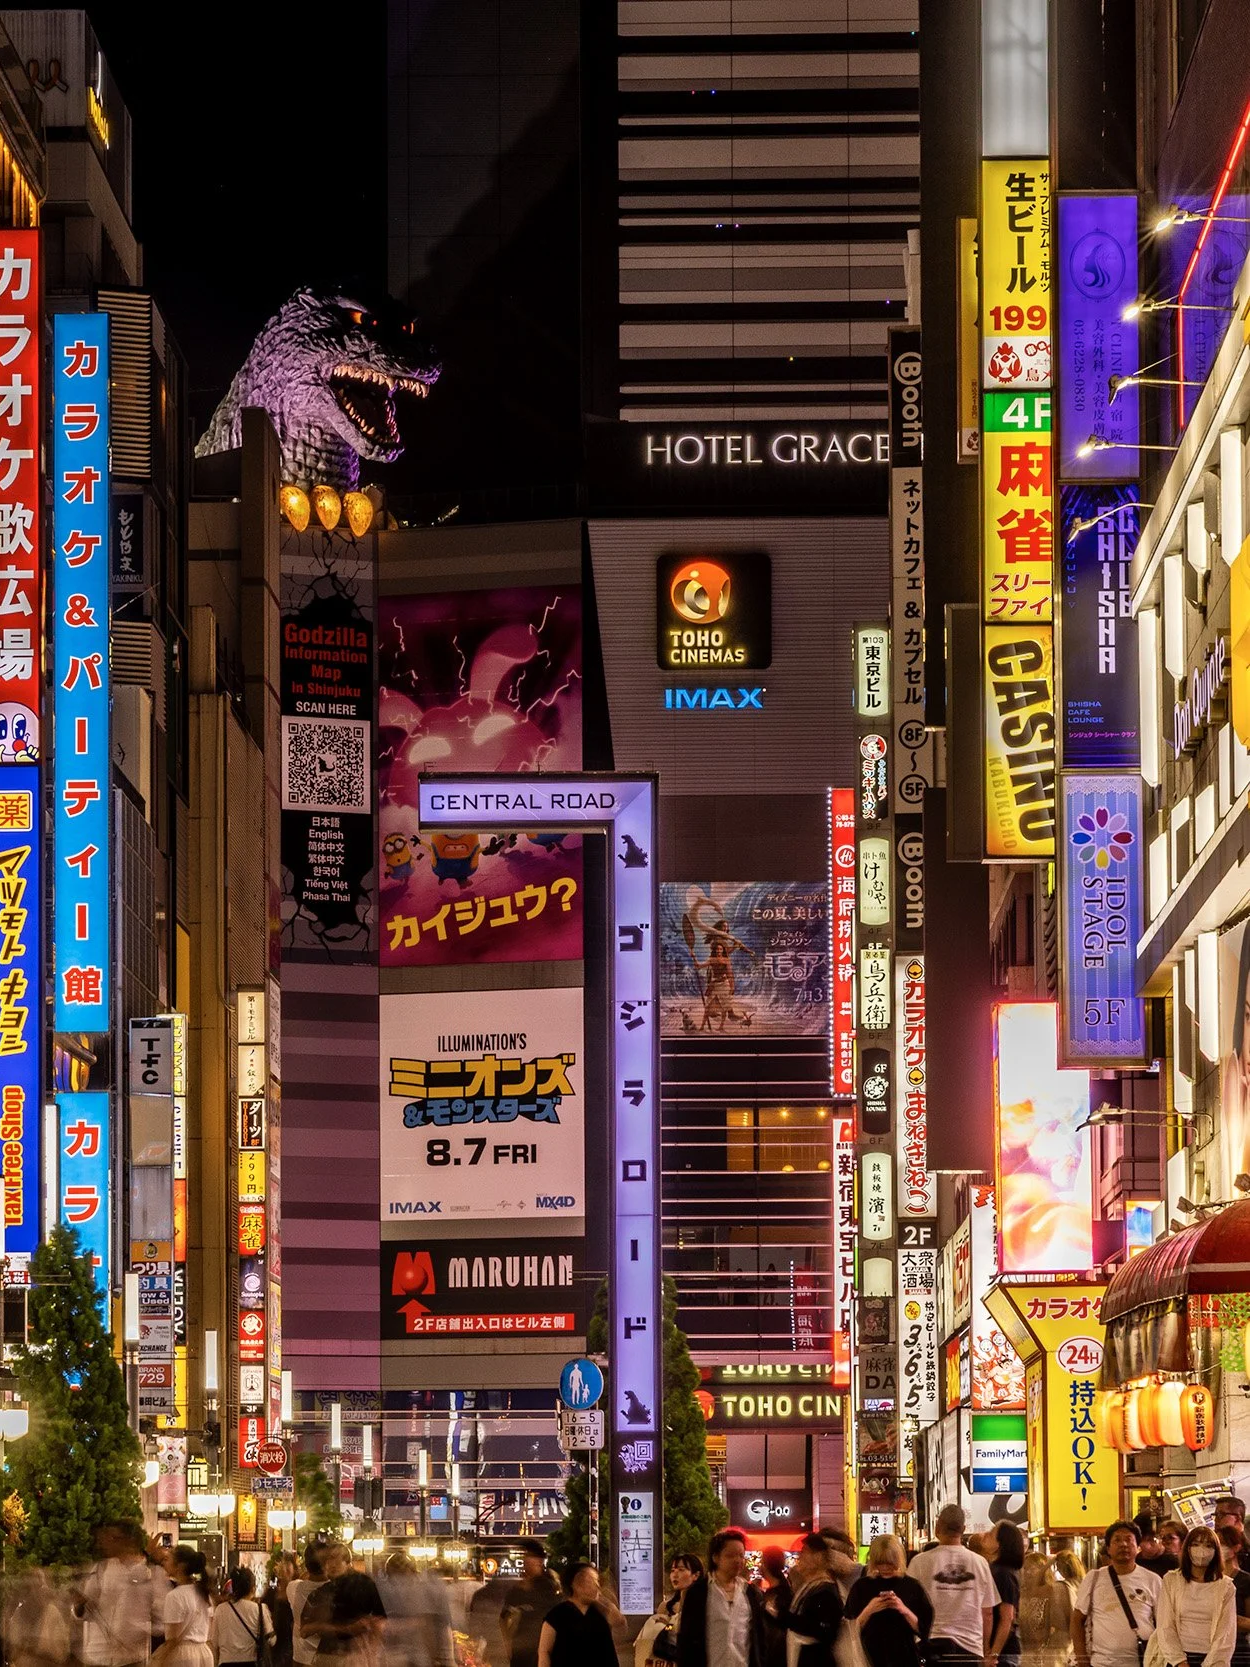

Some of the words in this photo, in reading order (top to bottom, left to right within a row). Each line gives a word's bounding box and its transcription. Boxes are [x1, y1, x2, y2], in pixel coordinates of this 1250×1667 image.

[1005, 172, 1037, 294] 生ビール
[989, 306, 1047, 331] 199
[646, 435, 763, 465] HOTEL
[996, 442, 1051, 564] 麻雀
[903, 480, 921, 590] ネットカフェ
[904, 602, 921, 619] &
[284, 622, 368, 648] Godzilla
[670, 631, 724, 647] TOHO
[285, 645, 368, 665] Information
[670, 648, 745, 664] CINEMAS
[61, 341, 103, 1004] カラオケ&パーティー館
[311, 664, 342, 682] Map
[865, 645, 882, 708] 東京ビル
[904, 628, 922, 705] カプセル
[306, 682, 361, 698] Shinjuku
[663, 688, 763, 709] IMAX
[295, 700, 326, 714] SCAN
[329, 703, 357, 717] HERE
[430, 794, 542, 810] CENTRAL
[550, 793, 615, 809] ROAD
[311, 816, 341, 828] 日本語
[308, 828, 345, 842] English
[307, 840, 346, 853] 简体中文
[312, 865, 341, 878] 한국어
[302, 890, 328, 901] Phasa
[331, 891, 350, 902] Thai
[1082, 876, 1104, 968] STAGE
[1105, 876, 1127, 951] IDOL
[1084, 999, 1125, 1026] 5F
[904, 979, 925, 1067] カラオケ
[437, 1033, 527, 1053] ILLUMINATION'S
[389, 1053, 576, 1098] ミニオンズ
[874, 1064, 887, 1073] 6F
[0, 1086, 24, 1138] Shop
[617, 922, 650, 1340] ゴジラロード
[426, 1137, 487, 1166] 8.7
[493, 1144, 537, 1164] FRI
[904, 1090, 931, 1215] まねきねこ
[389, 1201, 442, 1214] IMAX
[240, 1215, 263, 1250] 麻雀
[904, 1226, 931, 1245] 2F
[902, 1251, 934, 1266] 大衆
[448, 1255, 574, 1288] MARUHAN
[902, 1273, 935, 1289] 酒場
[1066, 1345, 1099, 1364] 24H
[139, 1373, 165, 1384] 729
[722, 1395, 792, 1417] TOHO
[260, 1452, 284, 1464] 消火栓
[995, 1475, 1010, 1491] 酒
